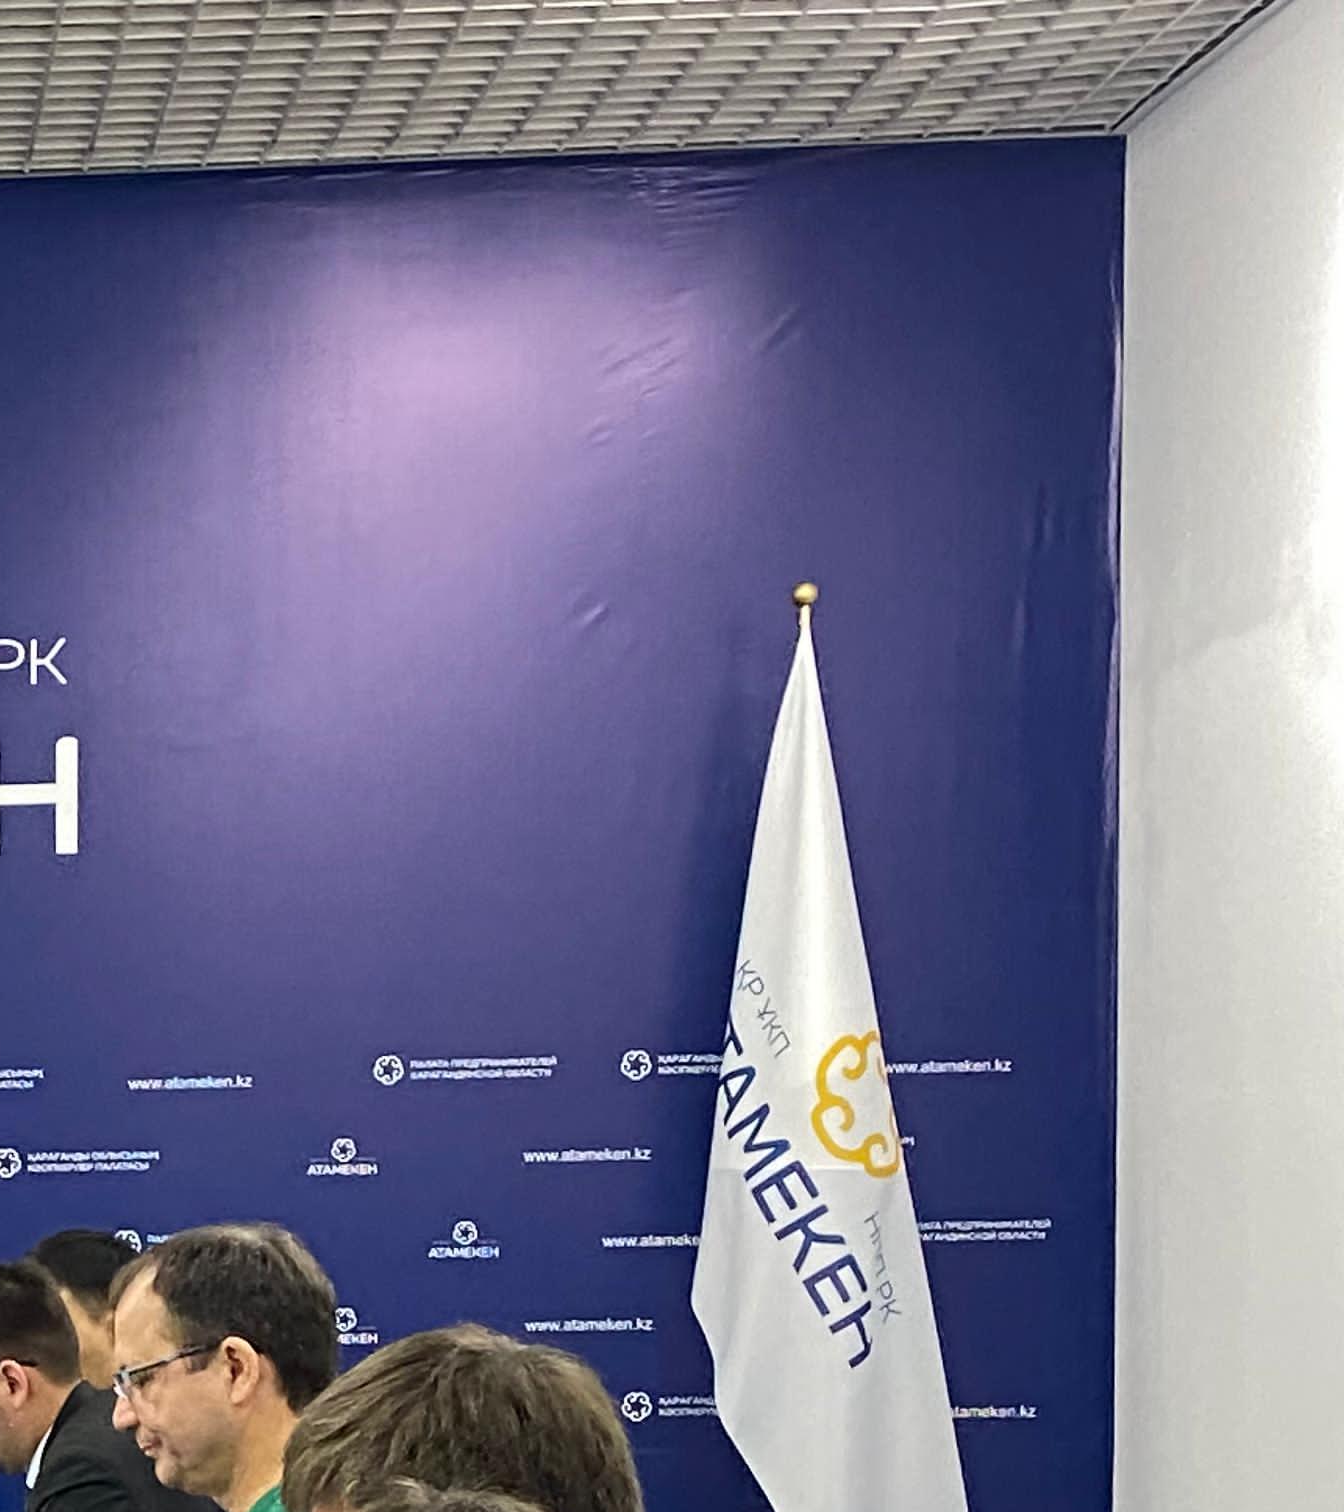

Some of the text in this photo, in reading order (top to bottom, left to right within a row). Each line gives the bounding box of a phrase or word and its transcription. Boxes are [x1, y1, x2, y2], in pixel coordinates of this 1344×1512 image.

[718, 1012, 874, 1369] ТАМЕКЕН
[602, 1234, 701, 1248] www.atameke
[952, 1405, 1037, 1419] tameken.kz
